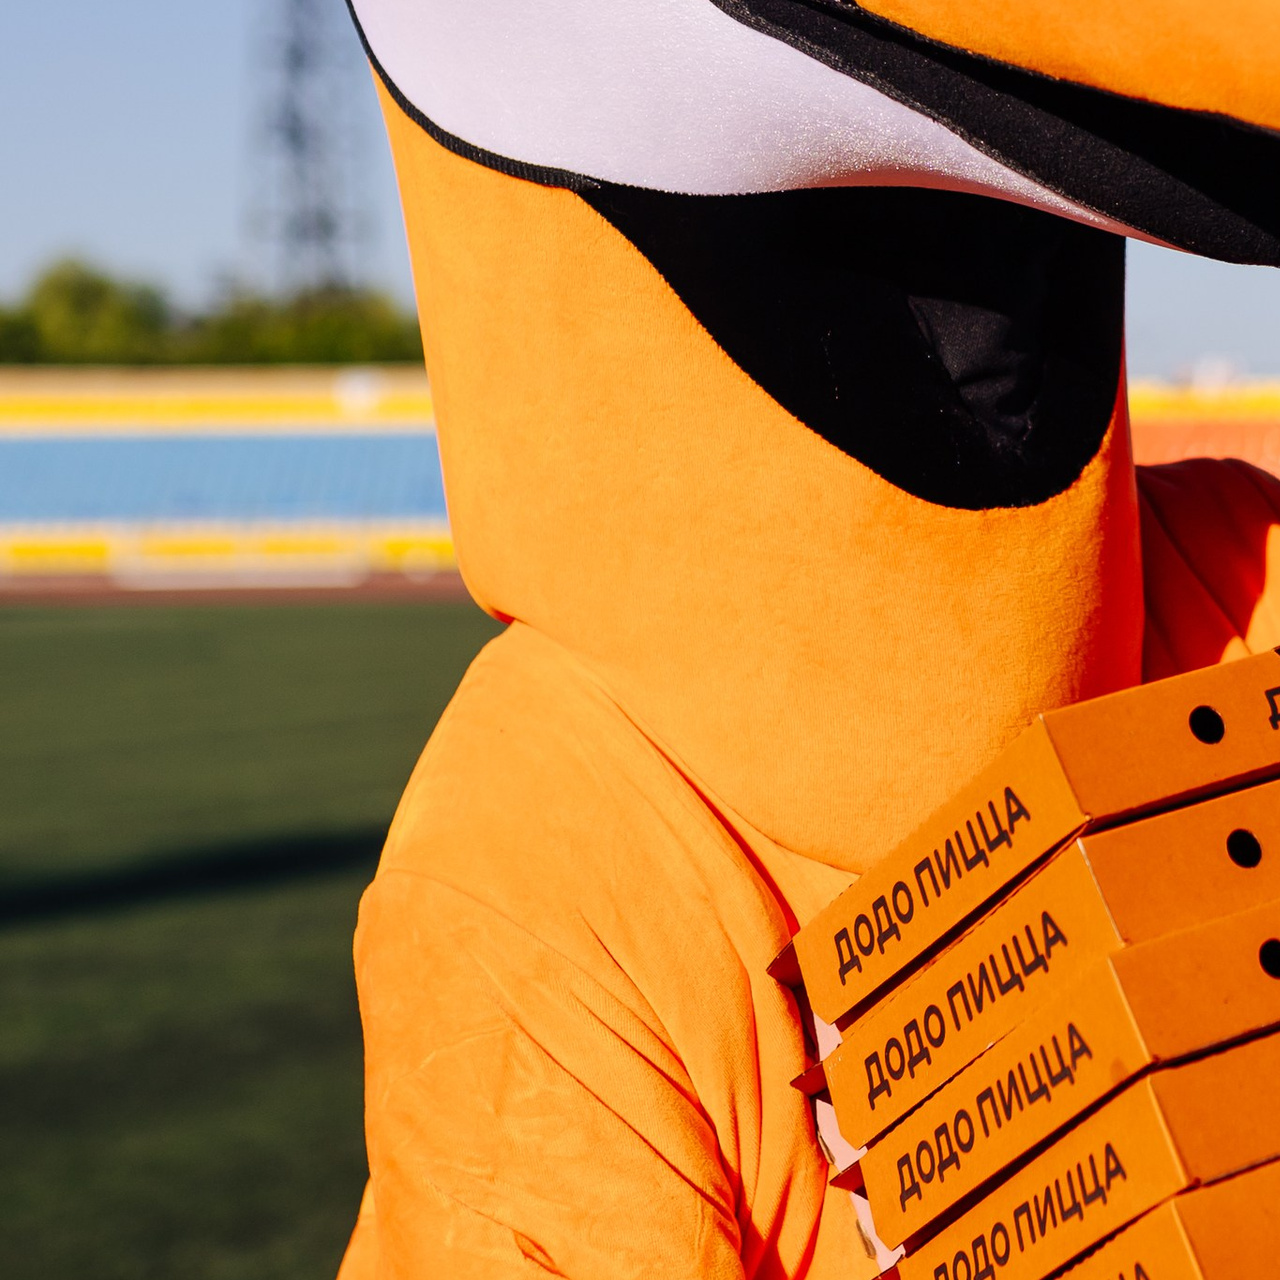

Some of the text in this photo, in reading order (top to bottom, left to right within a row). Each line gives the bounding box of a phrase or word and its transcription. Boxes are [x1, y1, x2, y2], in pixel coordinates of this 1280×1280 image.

[834, 787, 1031, 986] ДОДО ПИЦЦА
[864, 911, 1068, 1111] ДОДО ПИЦЦА
[897, 1023, 1092, 1212] ДОДО ПИЦЦА
[1013, 1143, 1126, 1252] ПИЦЦА
